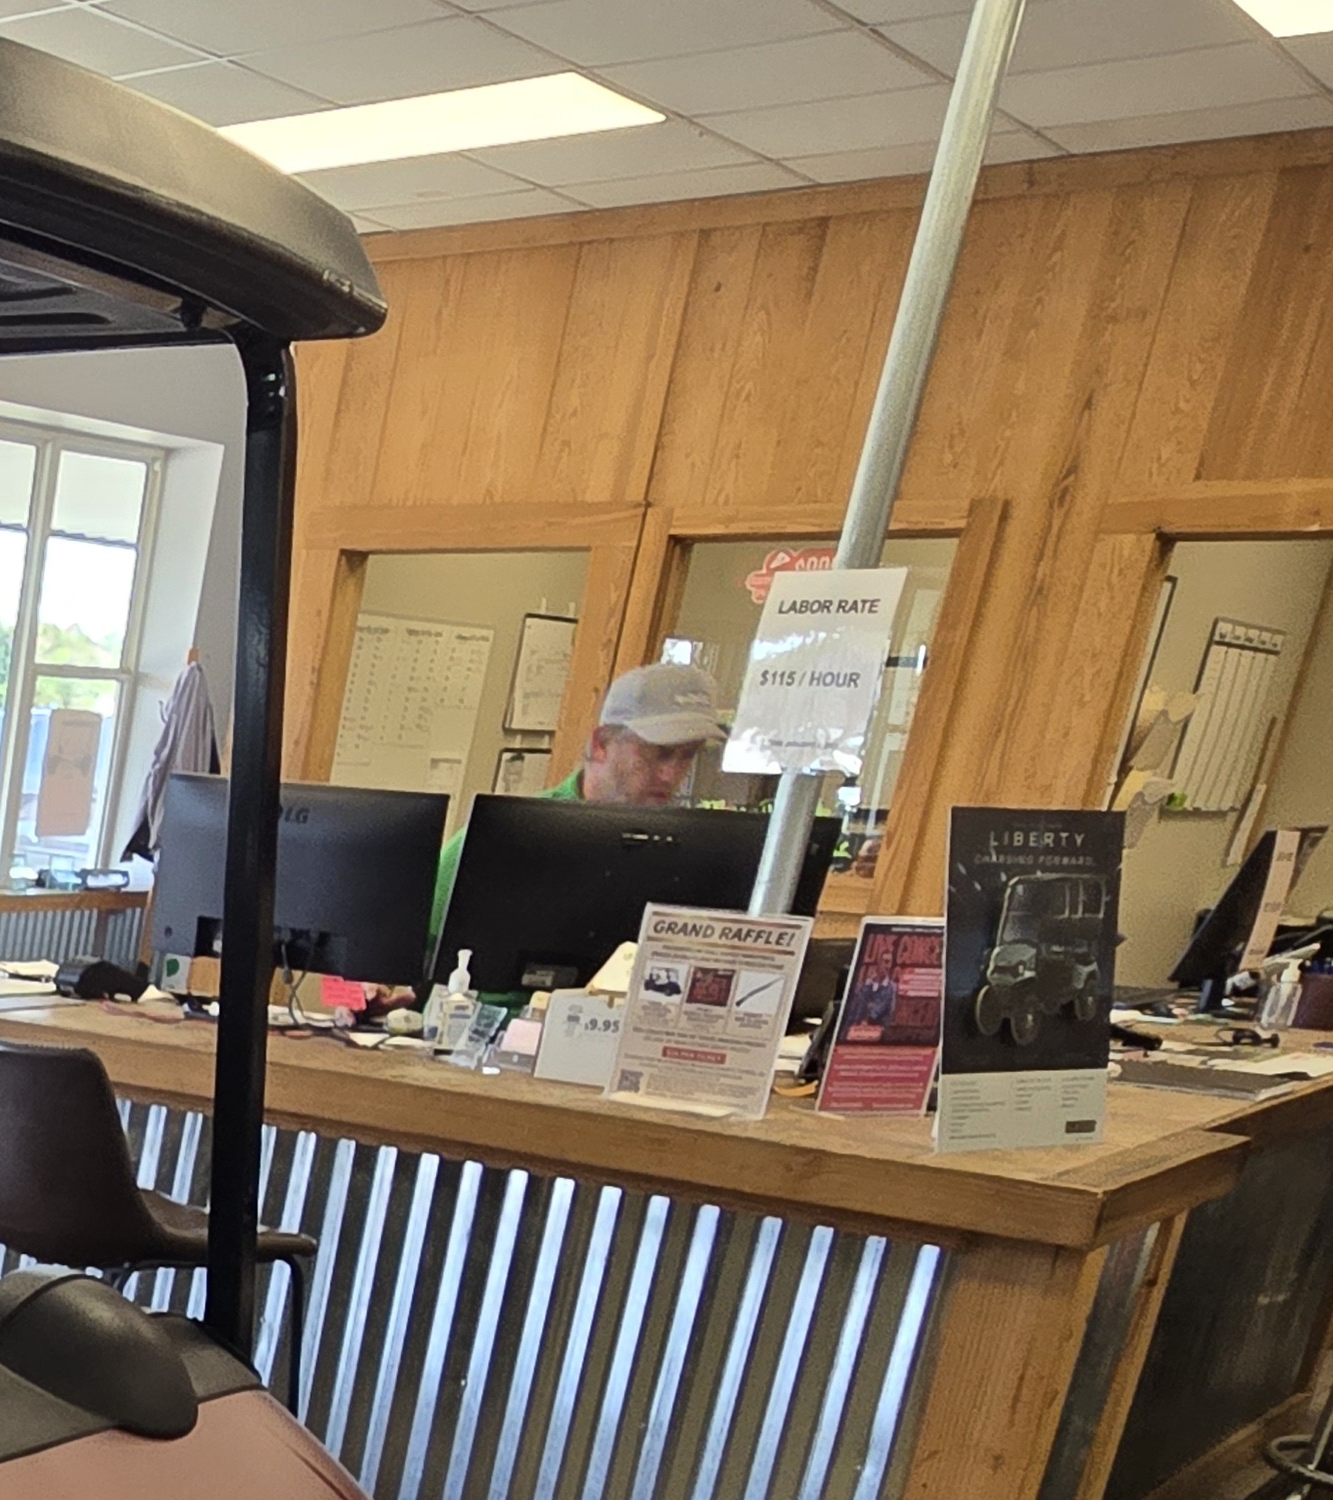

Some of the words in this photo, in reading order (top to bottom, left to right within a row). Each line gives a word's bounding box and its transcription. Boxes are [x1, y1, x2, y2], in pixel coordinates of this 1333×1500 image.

[778, 599, 832, 614] LABOR
[836, 598, 881, 614] RATE
[759, 669, 797, 687] $115
[808, 671, 861, 688] HOUR
[989, 831, 1085, 847] LIBERTY
[653, 919, 715, 939] GRAND
[718, 926, 796, 947] RAFFLE!
